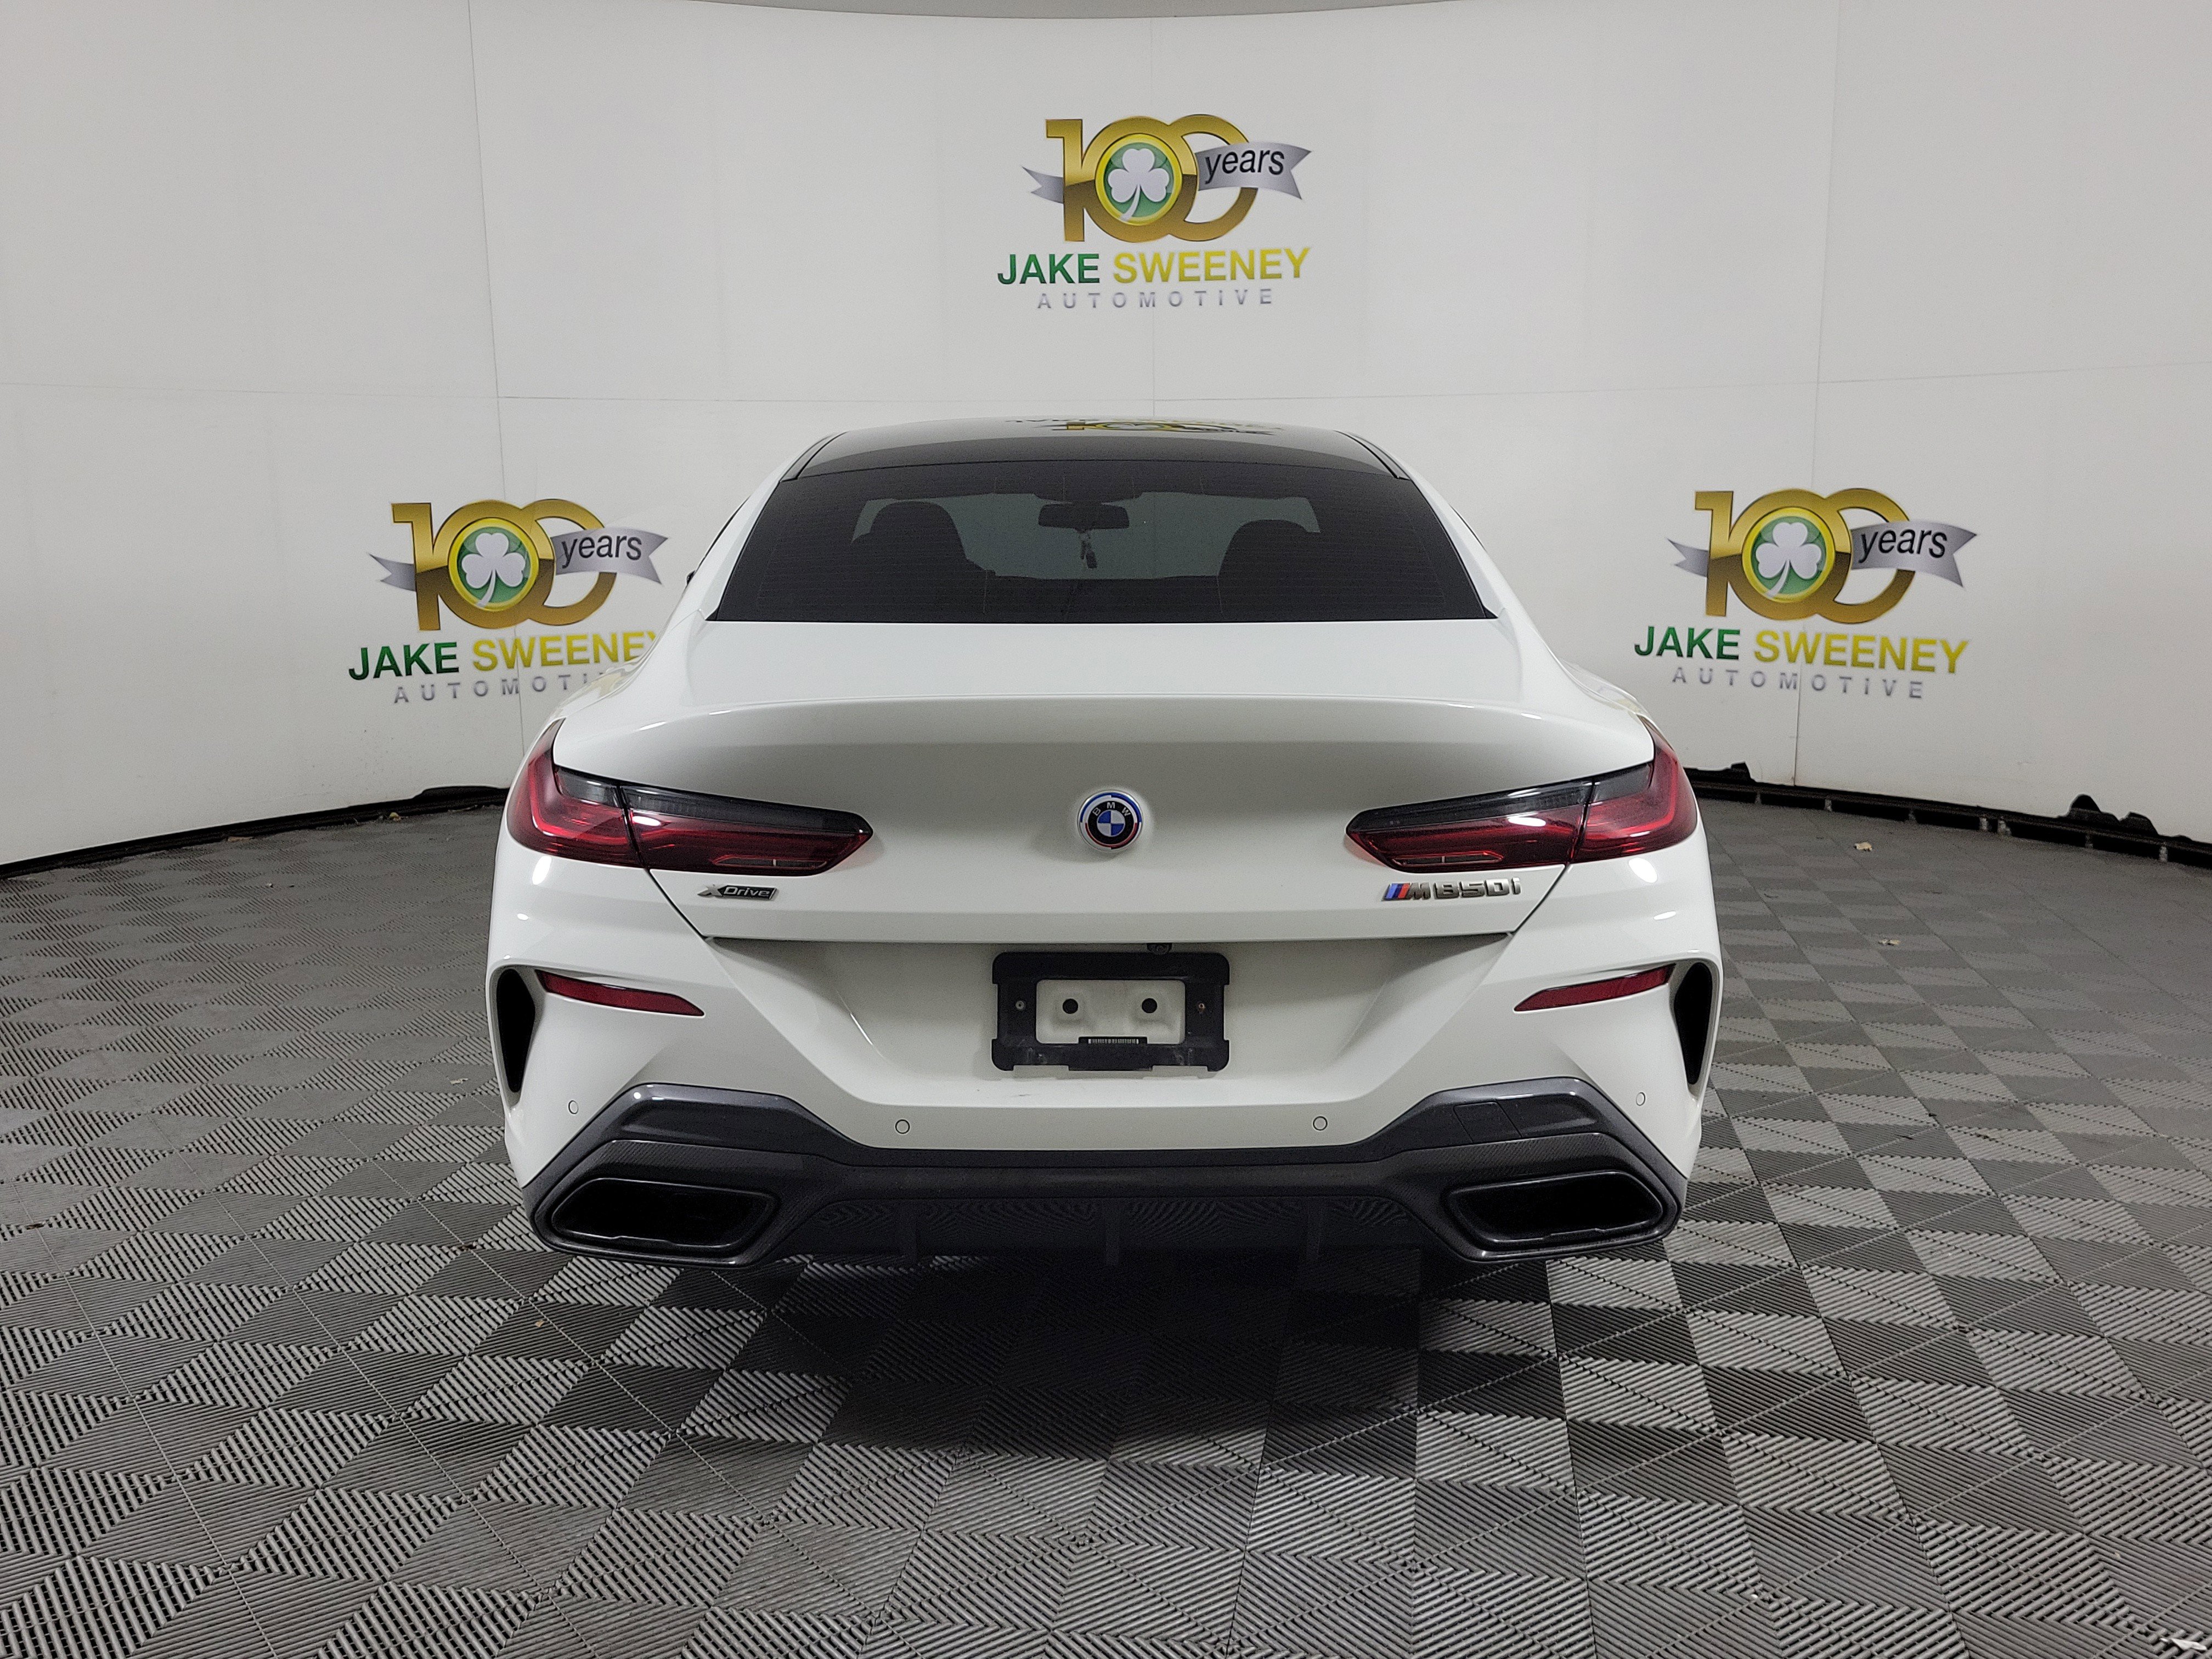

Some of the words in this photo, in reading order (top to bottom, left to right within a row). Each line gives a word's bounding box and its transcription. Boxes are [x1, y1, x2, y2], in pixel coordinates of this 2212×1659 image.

[1046, 114, 1259, 243] 100
[1205, 148, 1285, 184] years
[997, 253, 1100, 285] JAKE
[1113, 247, 1312, 284] SWEENEY
[1037, 289, 1272, 309] AUTOMOTIVE
[391, 498, 617, 631] 100
[561, 534, 642, 569] years
[1695, 488, 1916, 624] 100
[1858, 526, 1948, 563] years
[348, 641, 460, 681] JAKE
[472, 631, 656, 672] SWEENE
[1634, 626, 1741, 660] JAKE
[1753, 630, 1969, 674] SWEENEY
[393, 672, 603, 704] AUTOMOTI
[1672, 667, 1923, 698] AUTOMOTIVE
[1093, 802, 1131, 816] BMW
[1406, 877, 1521, 900] M850i
